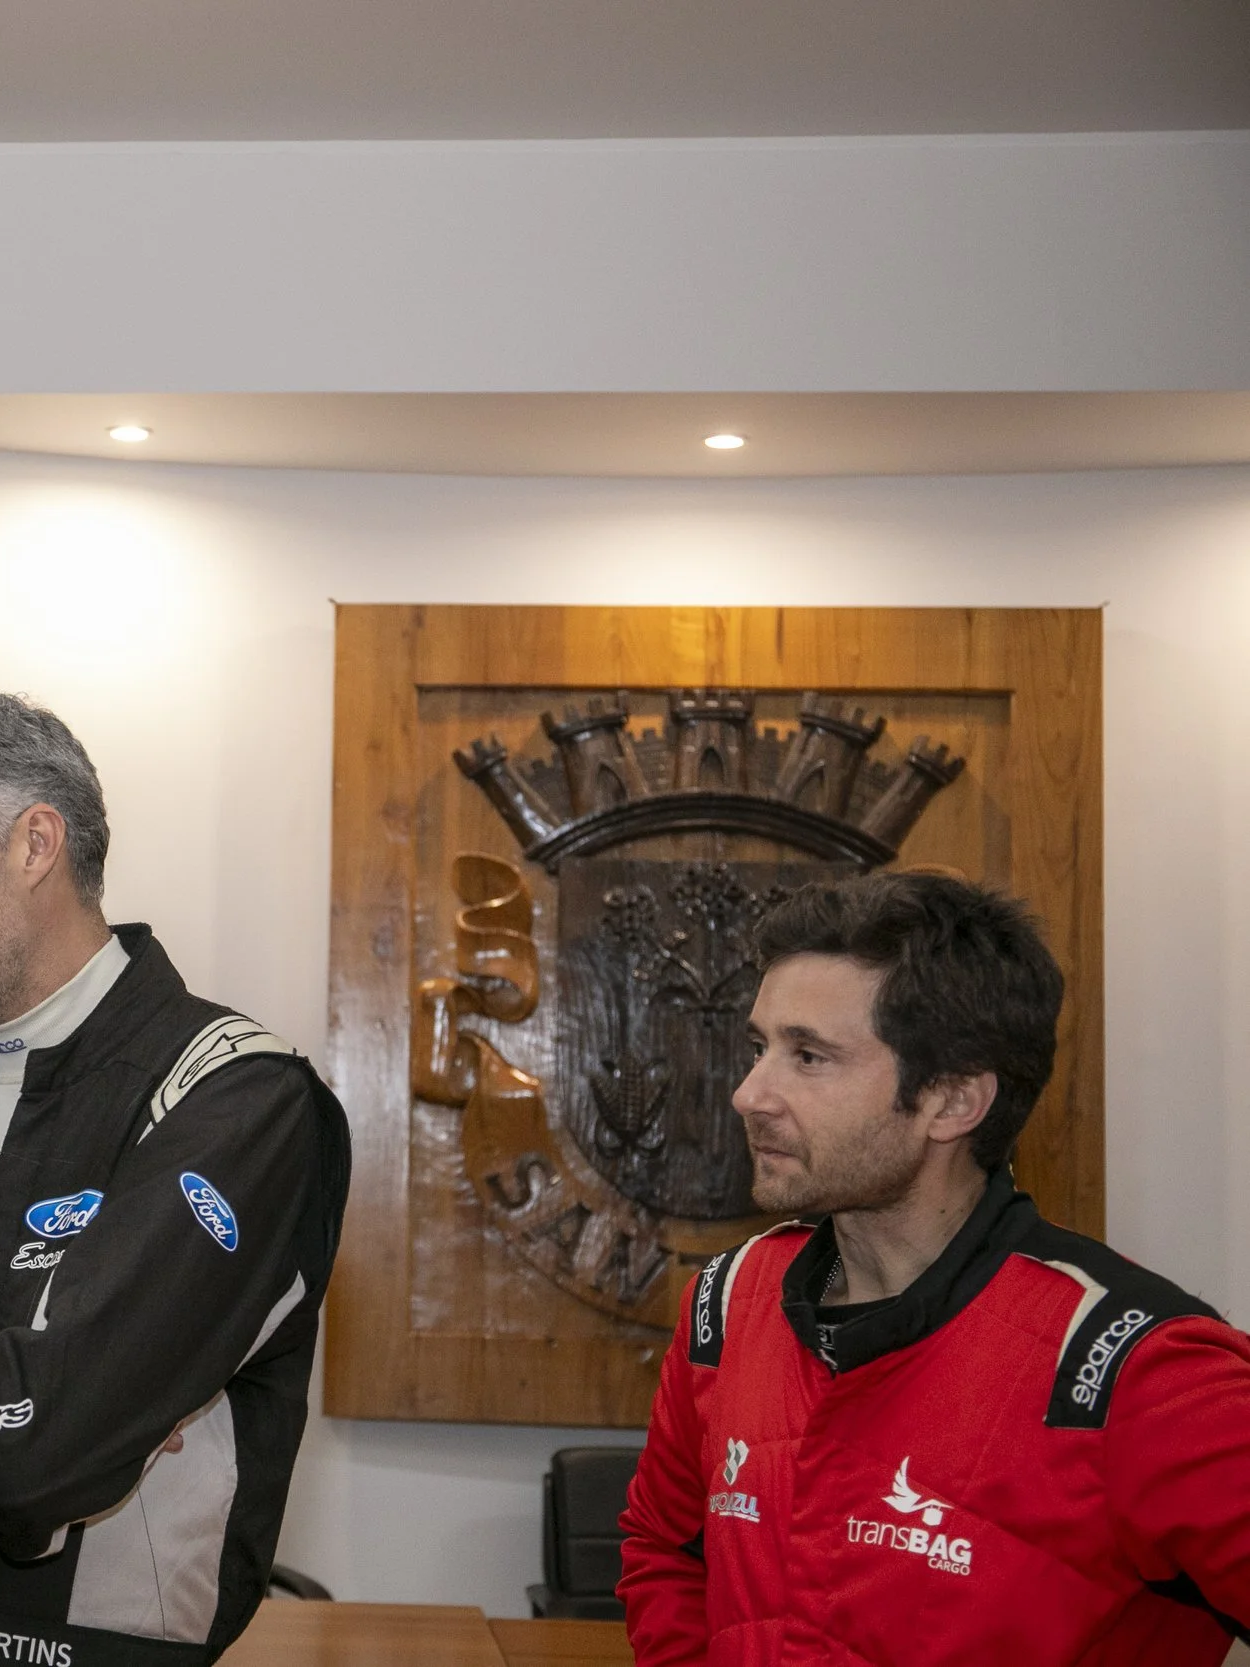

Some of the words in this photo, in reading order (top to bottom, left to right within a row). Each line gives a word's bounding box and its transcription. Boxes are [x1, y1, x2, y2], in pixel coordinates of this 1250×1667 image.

[43, 1196, 100, 1233] Ford
[188, 1187, 233, 1240] Ford
[485, 1153, 716, 1306] SAN
[1071, 1308, 1154, 1411] sparco
[847, 1515, 973, 1566] transBAG
[927, 1556, 971, 1577] CARGO
